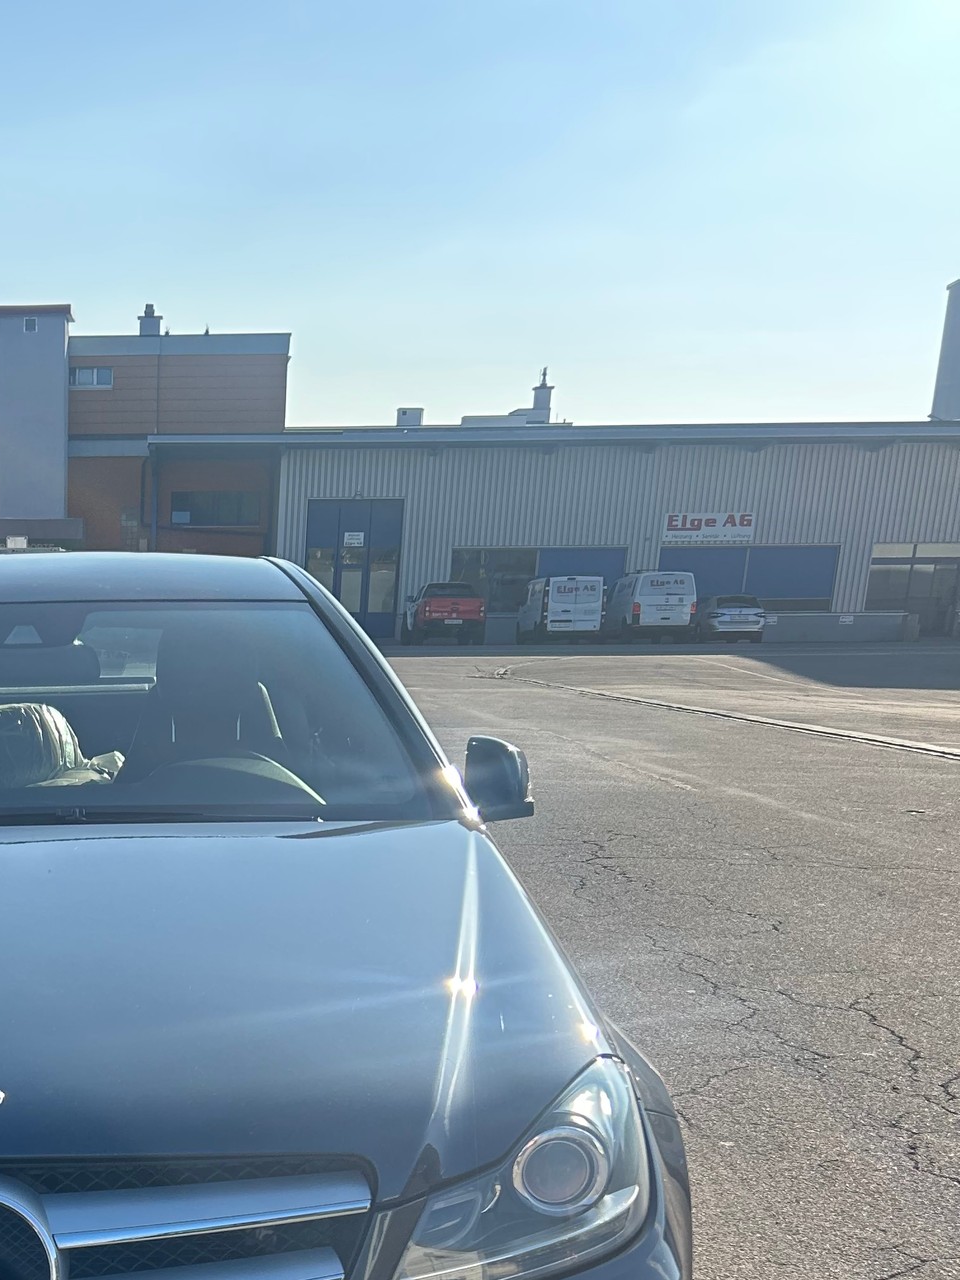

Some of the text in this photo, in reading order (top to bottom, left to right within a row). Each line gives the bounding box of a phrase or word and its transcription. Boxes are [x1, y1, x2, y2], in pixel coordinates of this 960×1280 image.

[667, 514, 752, 531] Elge AG
[582, 584, 597, 592] AG
